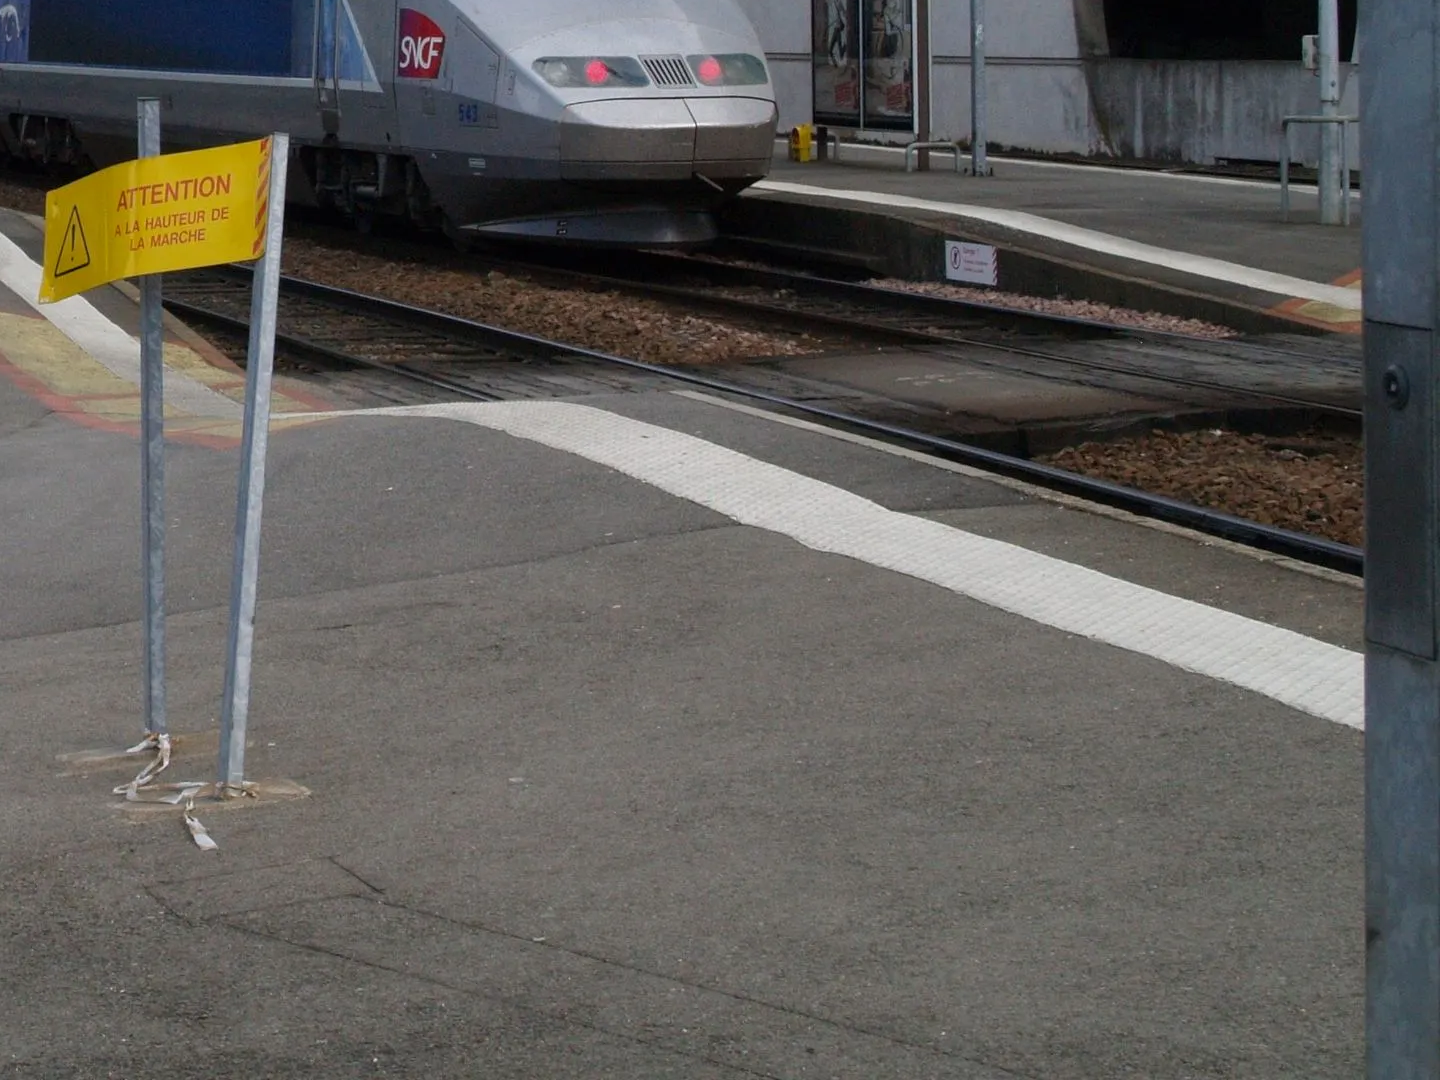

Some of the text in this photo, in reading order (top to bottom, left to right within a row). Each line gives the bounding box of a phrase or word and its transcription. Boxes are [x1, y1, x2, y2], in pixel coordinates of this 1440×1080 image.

[399, 36, 443, 69] SNCF
[116, 174, 231, 212] ATTENTION
[114, 206, 230, 237] A LA HAUTEUR DE
[129, 228, 207, 252] LA MARCHE
